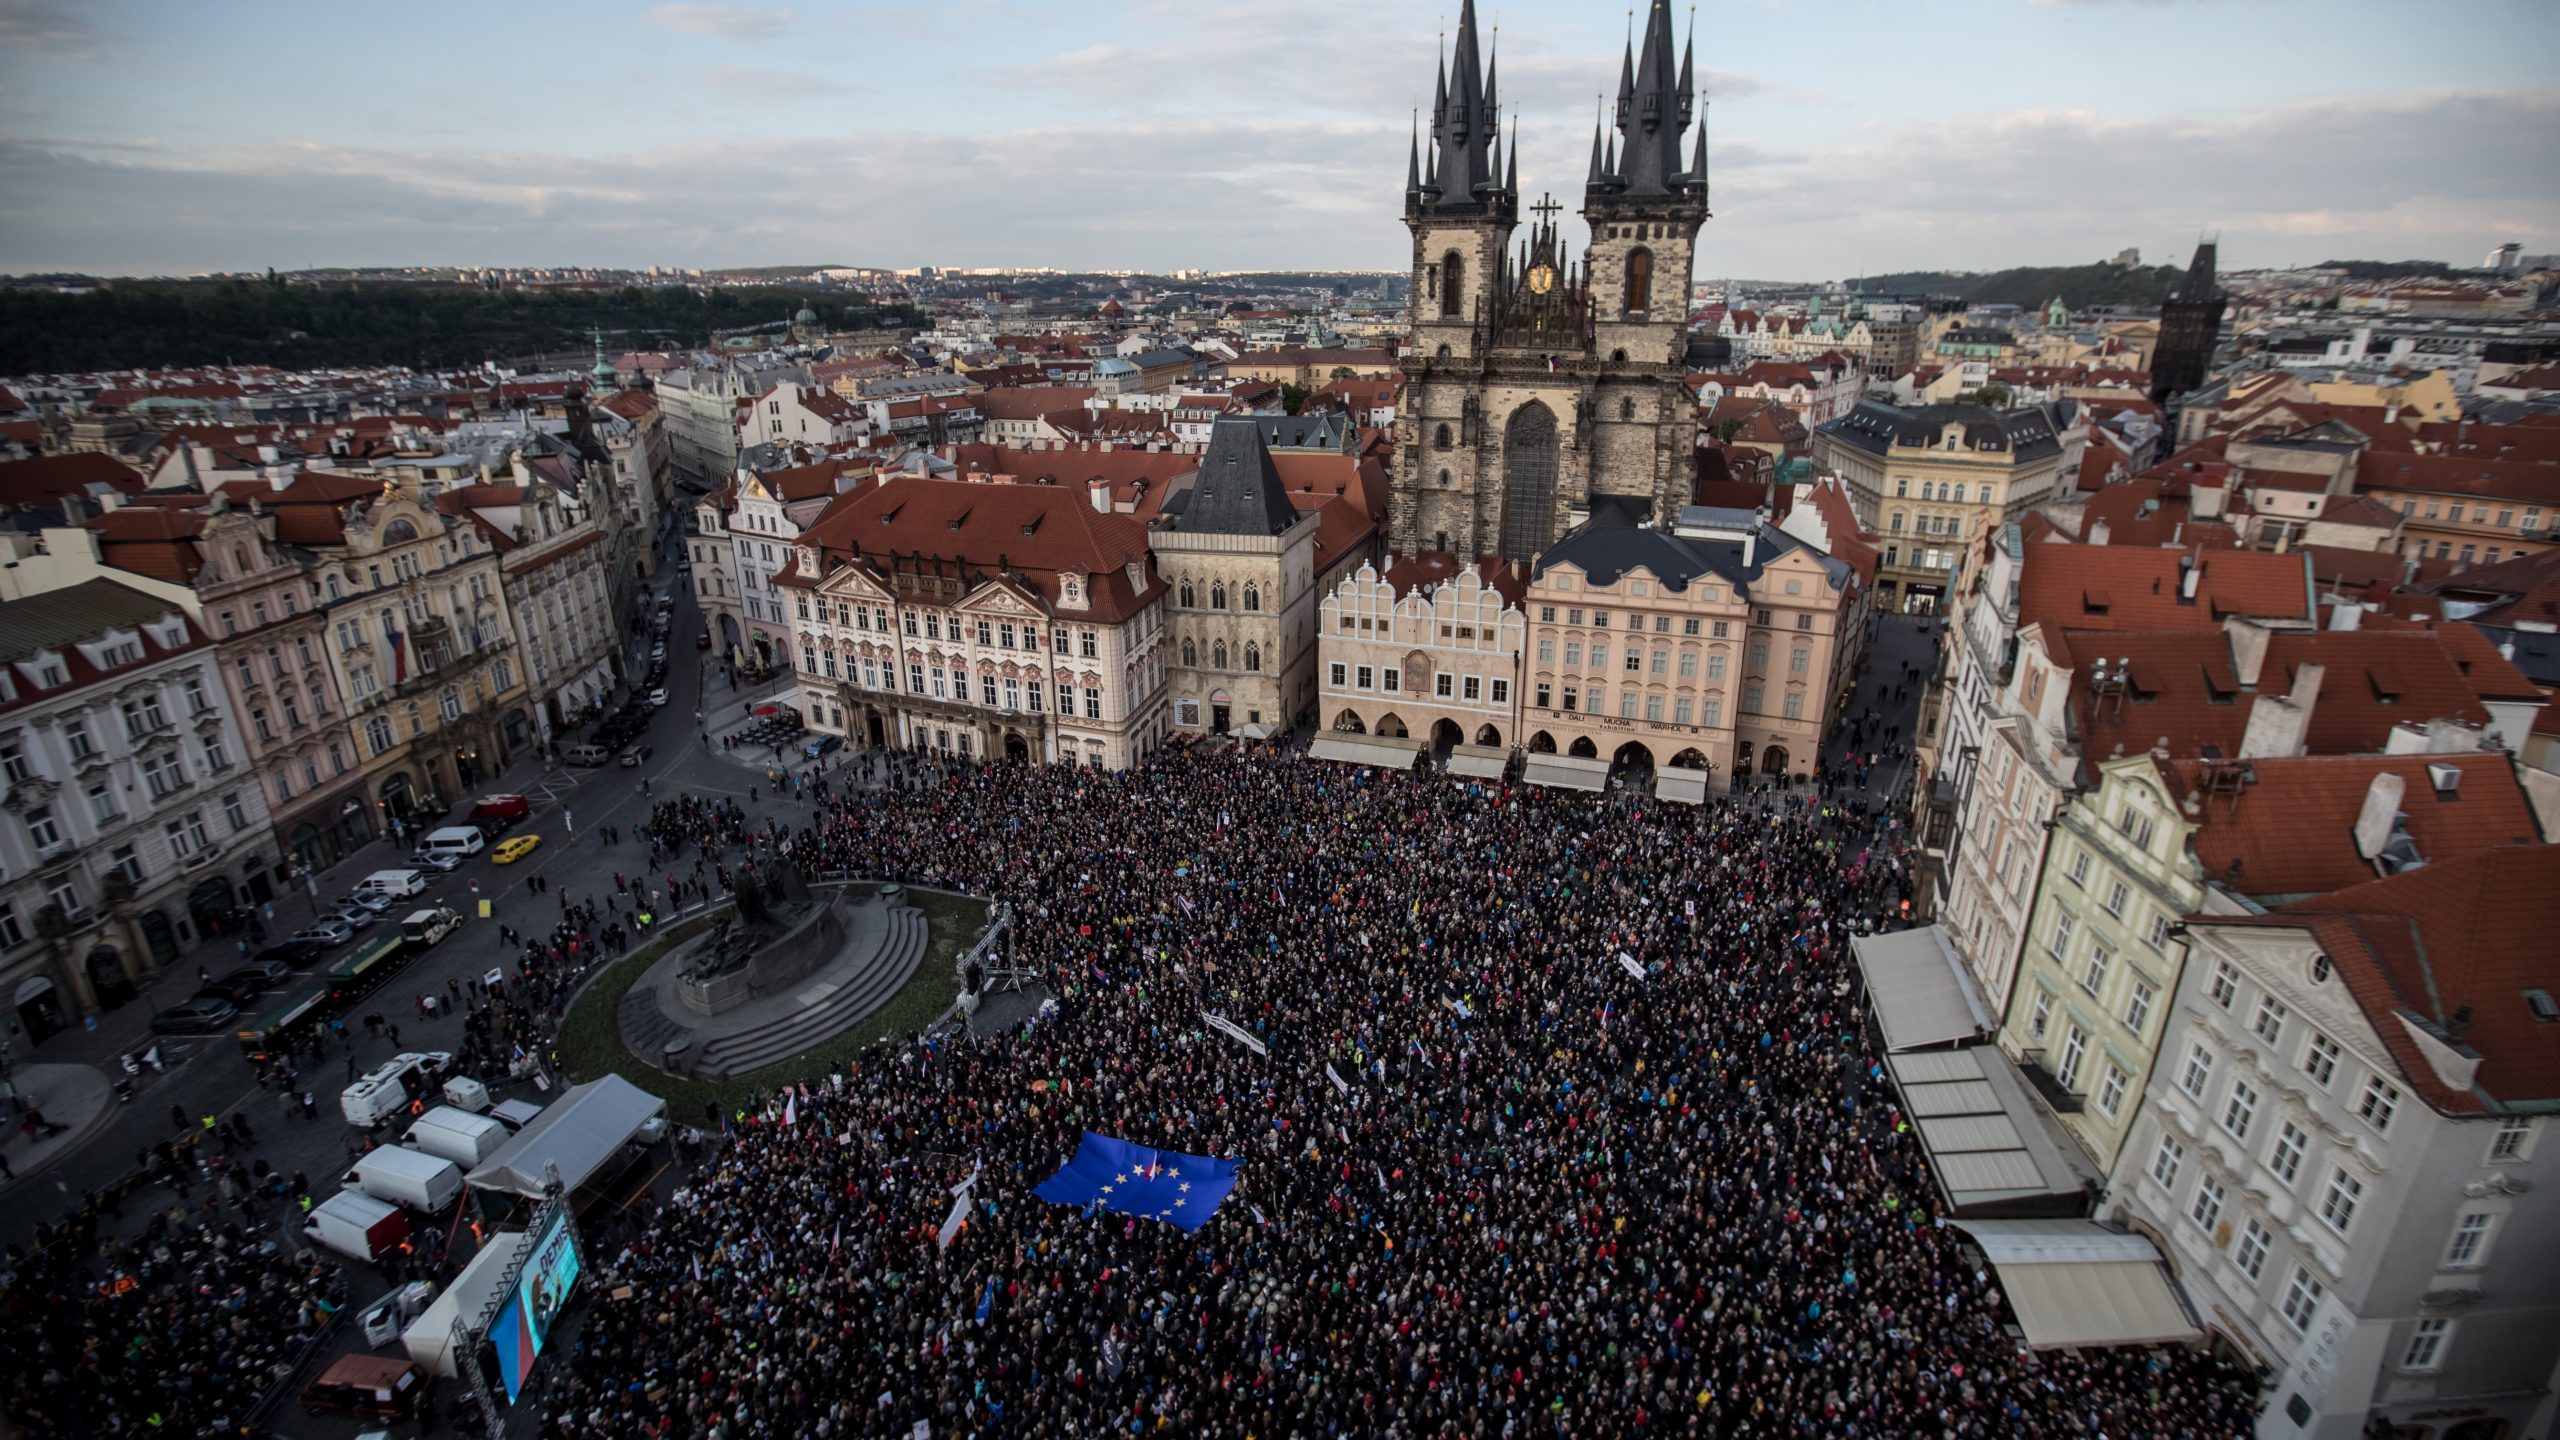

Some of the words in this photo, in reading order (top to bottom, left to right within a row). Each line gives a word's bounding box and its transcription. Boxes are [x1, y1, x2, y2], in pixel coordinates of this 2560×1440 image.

[1603, 718, 1631, 727] MUCHA
[1599, 724, 1636, 732] exhibition
[1650, 722, 1682, 733] WARHOL
